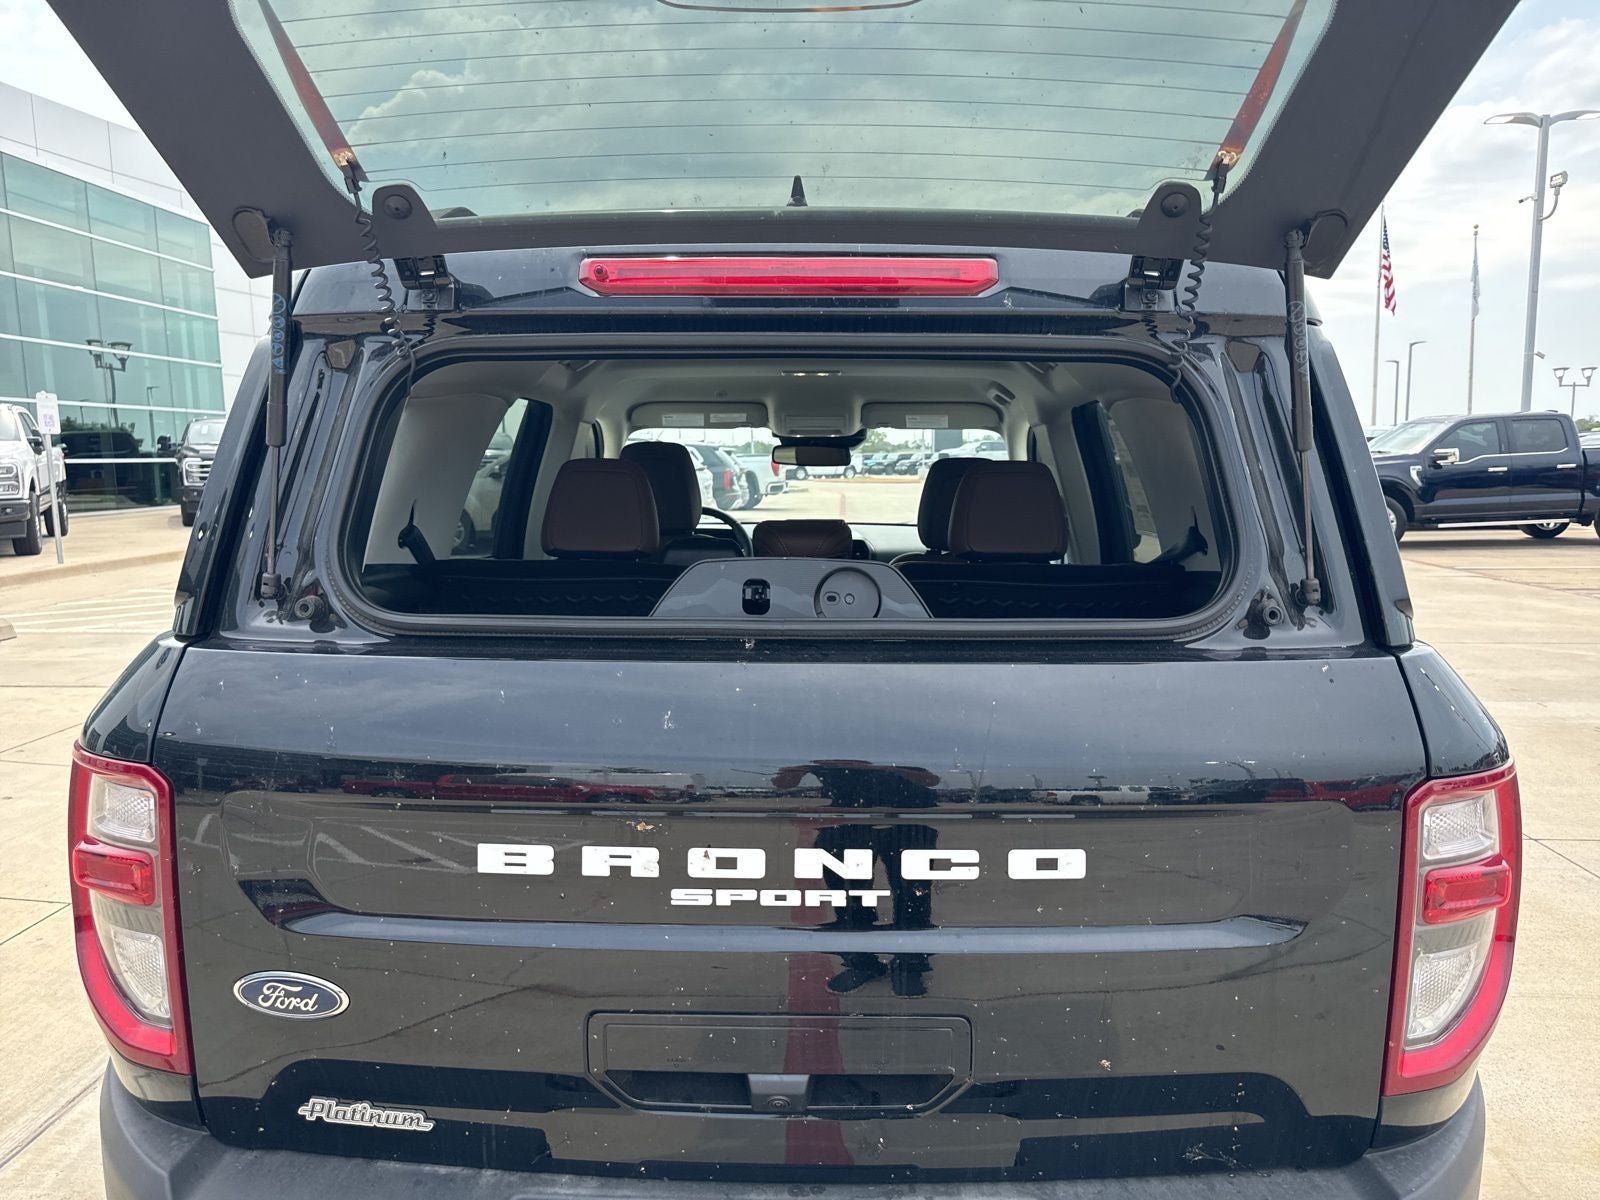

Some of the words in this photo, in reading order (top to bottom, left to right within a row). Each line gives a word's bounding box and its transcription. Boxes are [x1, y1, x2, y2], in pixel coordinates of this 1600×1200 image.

[477, 842, 1087, 881] BRONCO
[670, 889, 892, 908] SPORT
[258, 982, 319, 1012] Ford
[298, 1097, 436, 1132] Platinum
